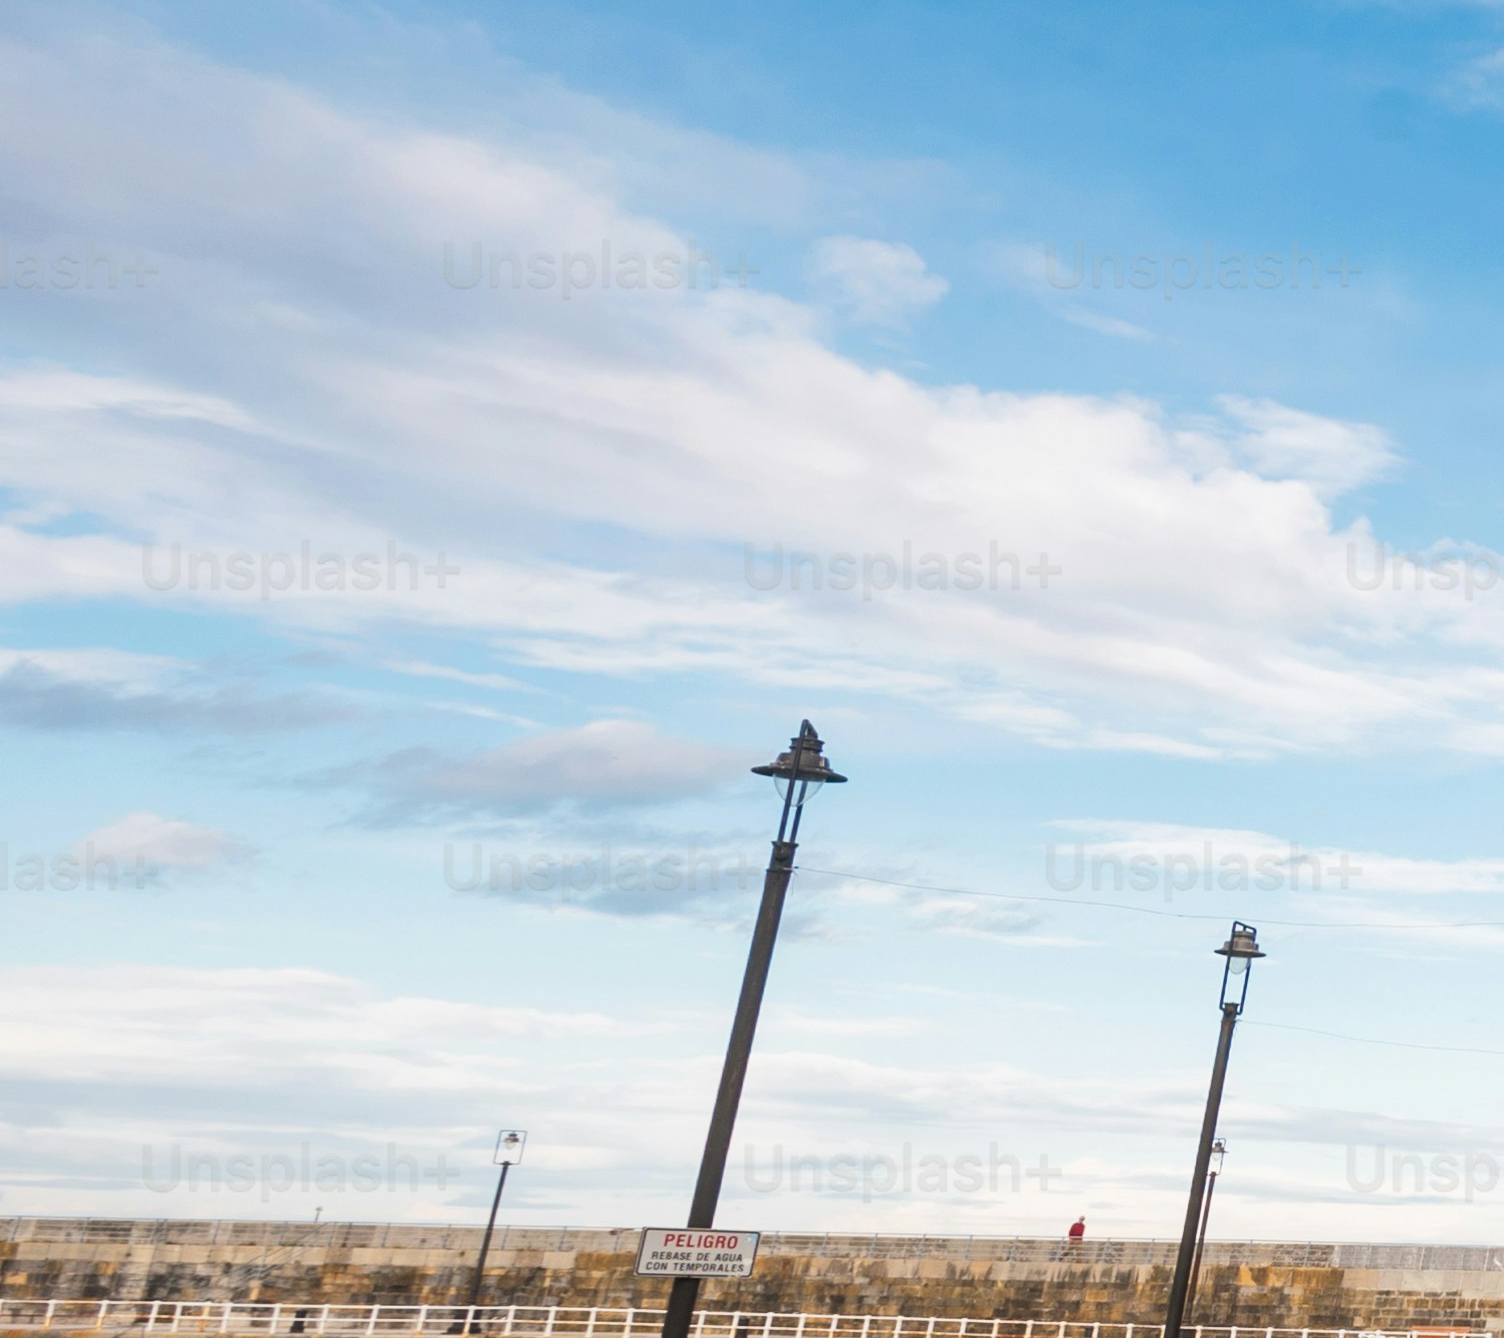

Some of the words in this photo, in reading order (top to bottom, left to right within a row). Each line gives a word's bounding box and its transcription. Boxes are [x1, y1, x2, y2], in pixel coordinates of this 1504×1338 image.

[663, 1233, 739, 1249] PELIGRO
[651, 1251, 691, 1261] REBASE
[696, 1252, 709, 1261] DE
[714, 1253, 743, 1262] AGUA
[645, 1261, 668, 1270] CON
[673, 1262, 744, 1272] TEMPORALES
